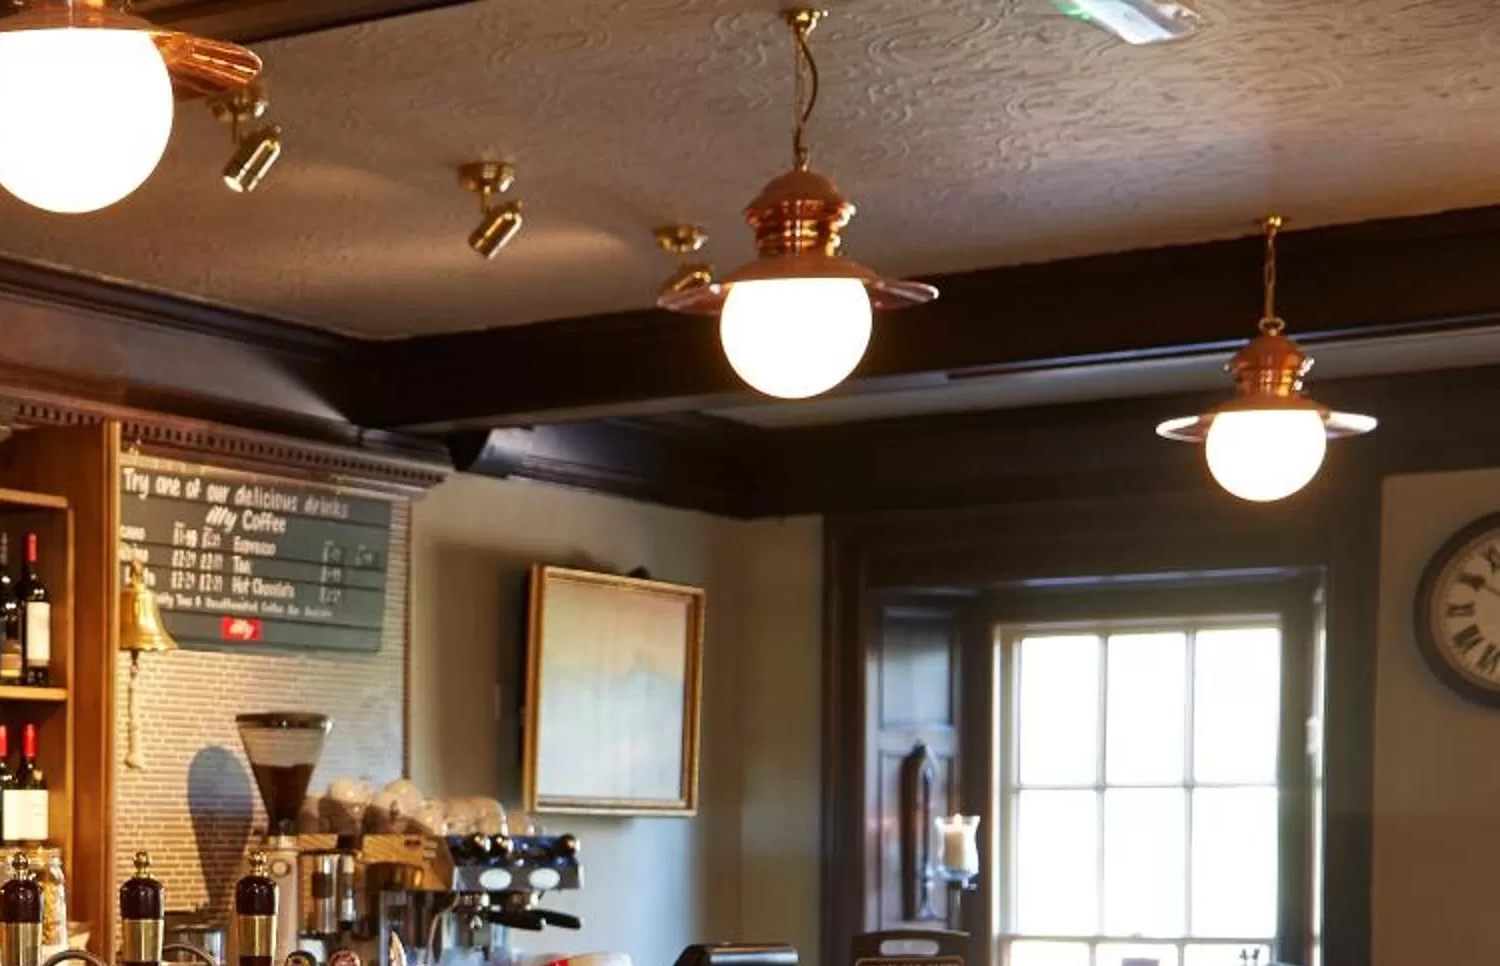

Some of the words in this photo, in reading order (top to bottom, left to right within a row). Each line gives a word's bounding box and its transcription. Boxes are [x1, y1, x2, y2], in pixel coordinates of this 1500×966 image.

[123, 467, 150, 501] Try
[154, 475, 181, 498] one
[185, 477, 202, 500] of
[206, 483, 231, 504] our
[234, 484, 299, 513] delicious
[303, 495, 350, 520] drinks
[241, 508, 288, 534] Coffee
